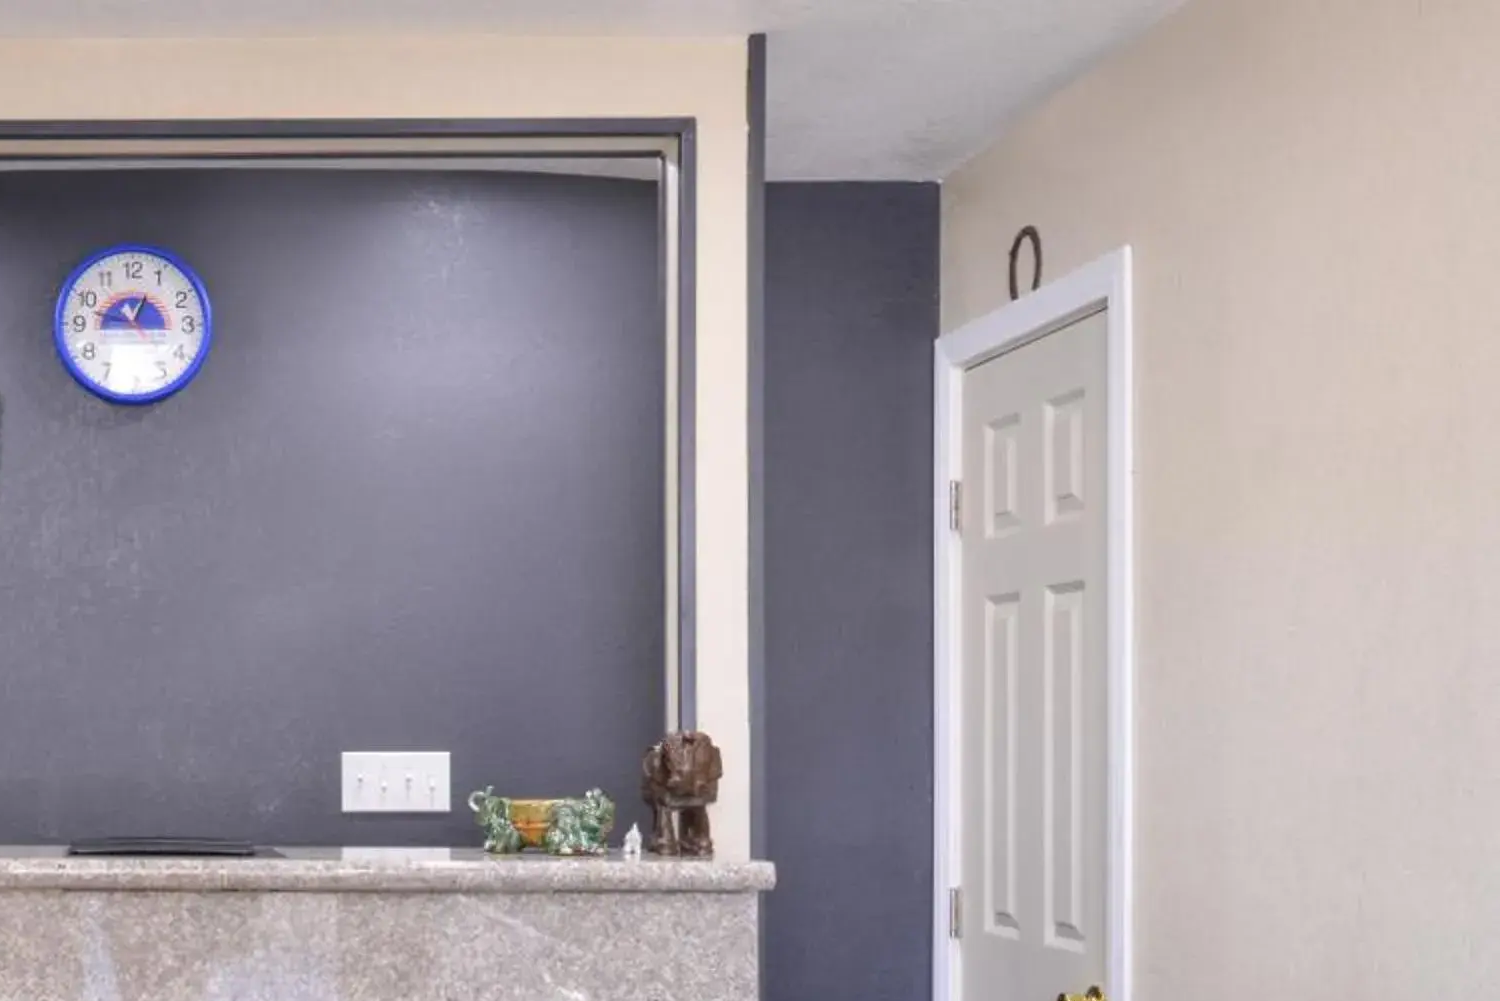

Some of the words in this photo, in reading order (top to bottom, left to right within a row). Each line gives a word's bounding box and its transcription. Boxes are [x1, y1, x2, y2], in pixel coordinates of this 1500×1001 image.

[100, 271, 112, 287] 11
[123, 261, 143, 279] 12
[154, 269, 162, 286] 1
[78, 290, 97, 308] 10
[175, 291, 187, 309] 2
[73, 315, 86, 333] 9
[182, 315, 195, 334] 3
[82, 342, 95, 360] 8
[173, 344, 185, 360] 4
[102, 362, 112, 380] 7
[154, 361, 168, 379] 5
